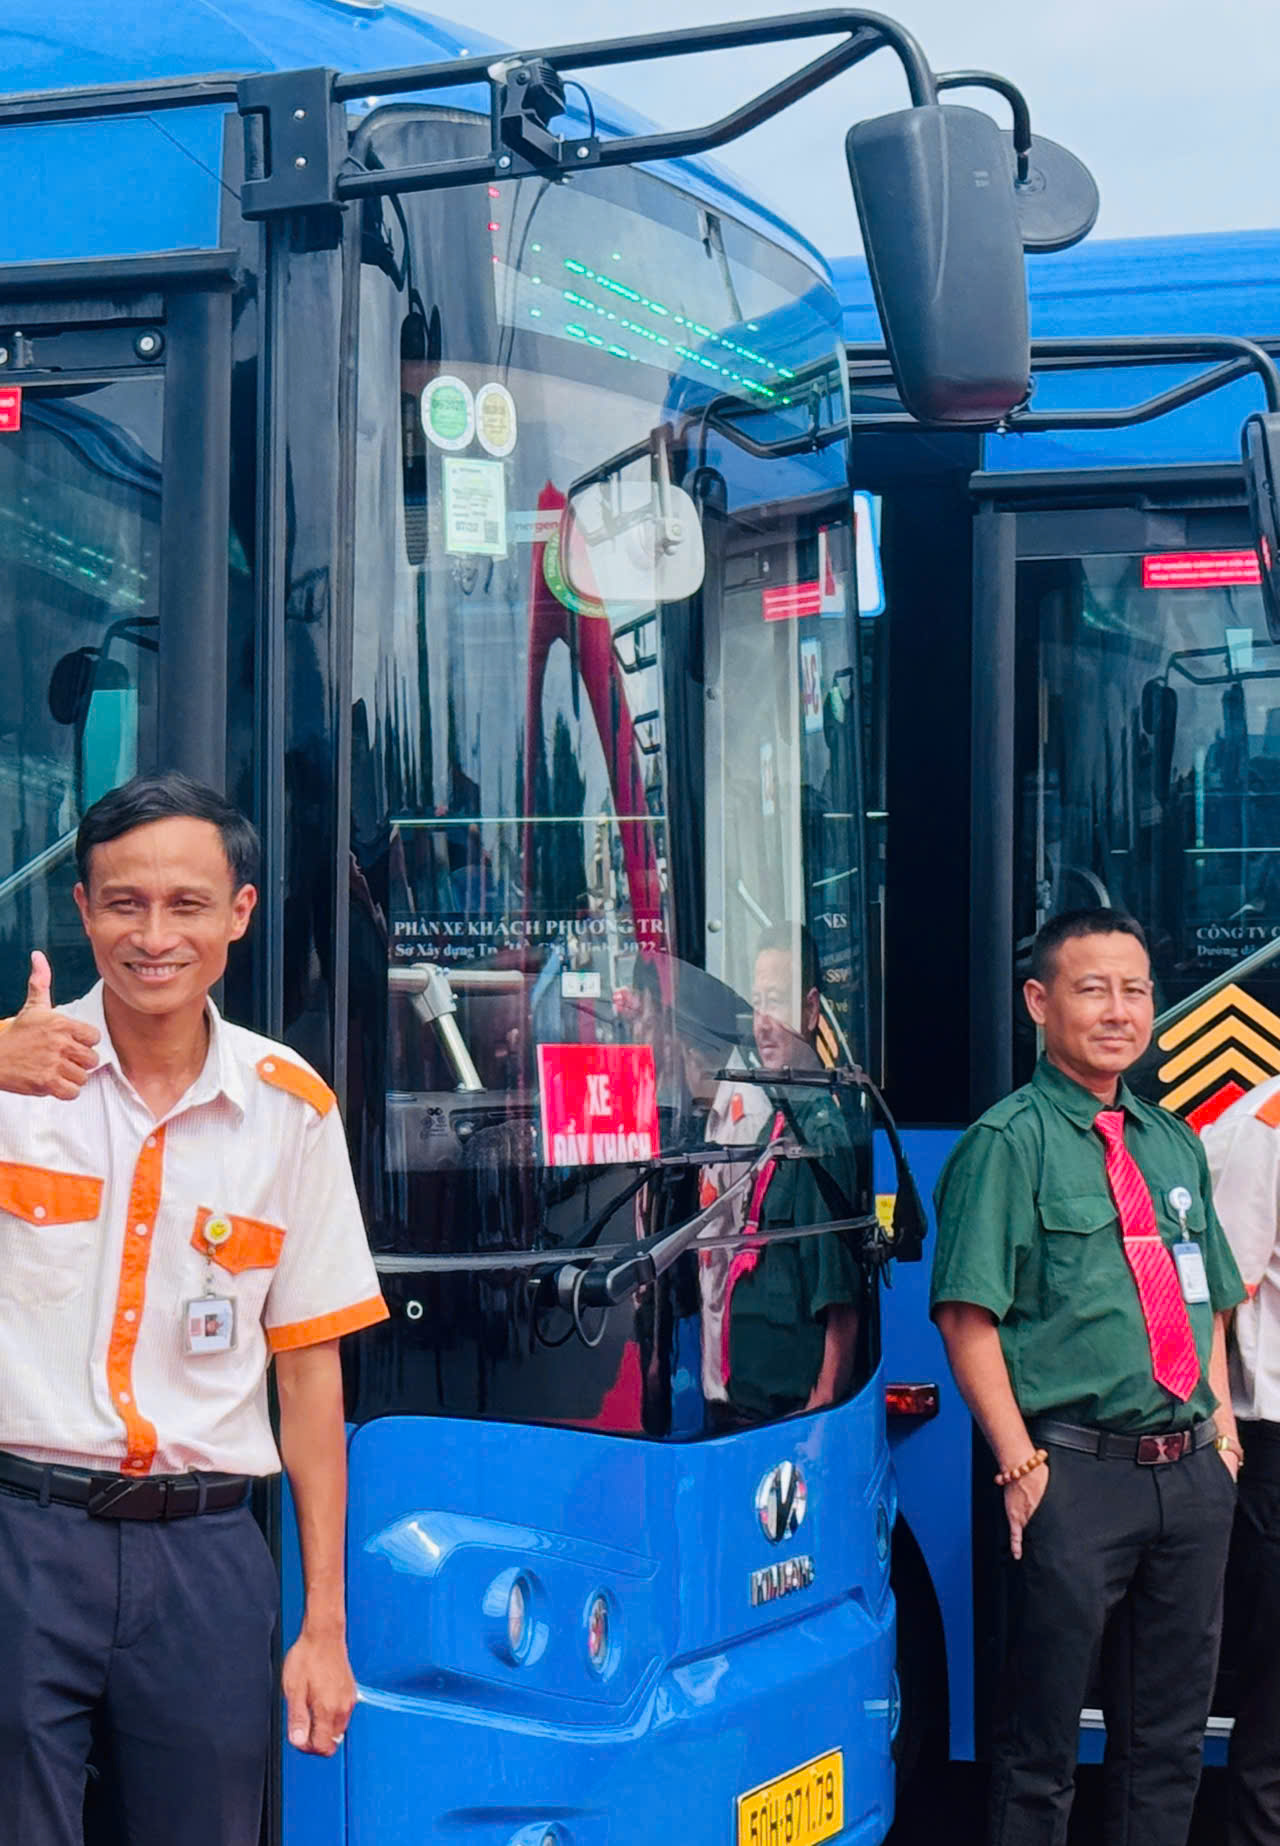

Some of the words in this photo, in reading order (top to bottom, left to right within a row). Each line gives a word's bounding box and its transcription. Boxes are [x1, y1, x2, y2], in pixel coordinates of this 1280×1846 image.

[442, 921, 465, 936] XE
[468, 916, 541, 936] KHÁCH
[636, 919, 668, 935] TR
[586, 1074, 612, 1116] XE
